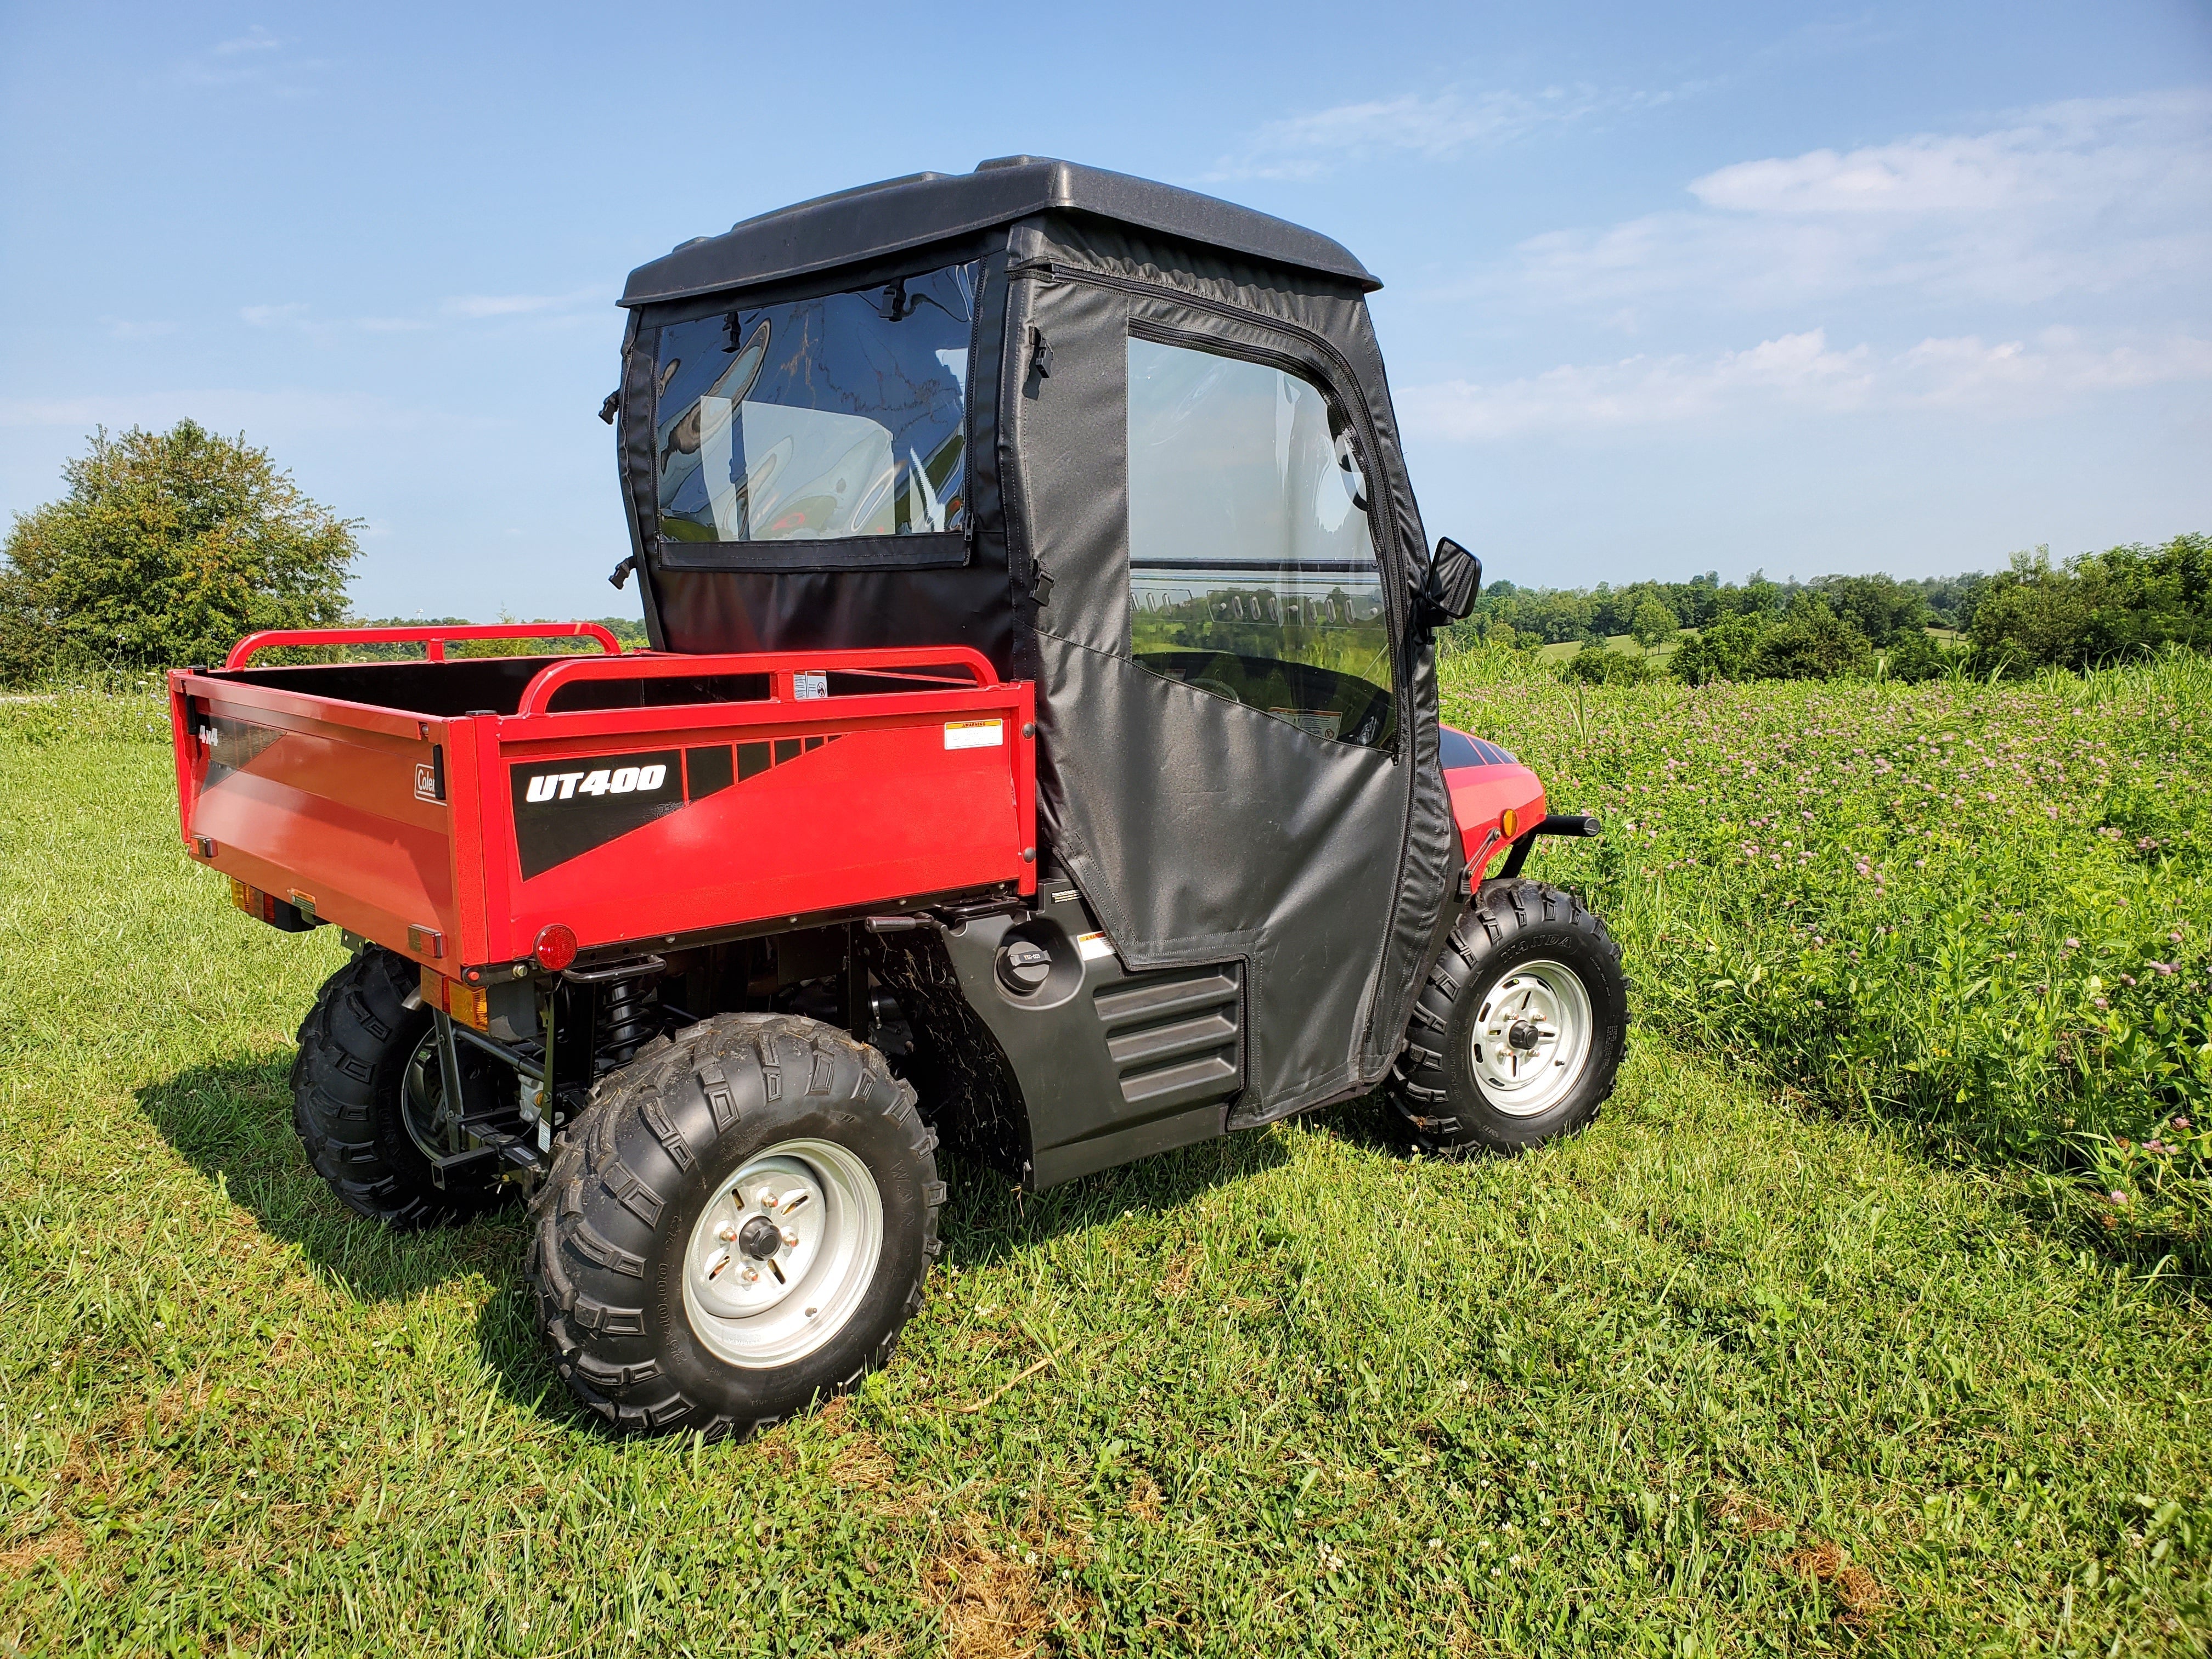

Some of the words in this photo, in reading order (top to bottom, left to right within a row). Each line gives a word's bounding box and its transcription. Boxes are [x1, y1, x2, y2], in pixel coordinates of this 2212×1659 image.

[199, 725, 218, 747] 4x4
[525, 764, 667, 803] UT400
[1500, 934, 1572, 963] WANDA
